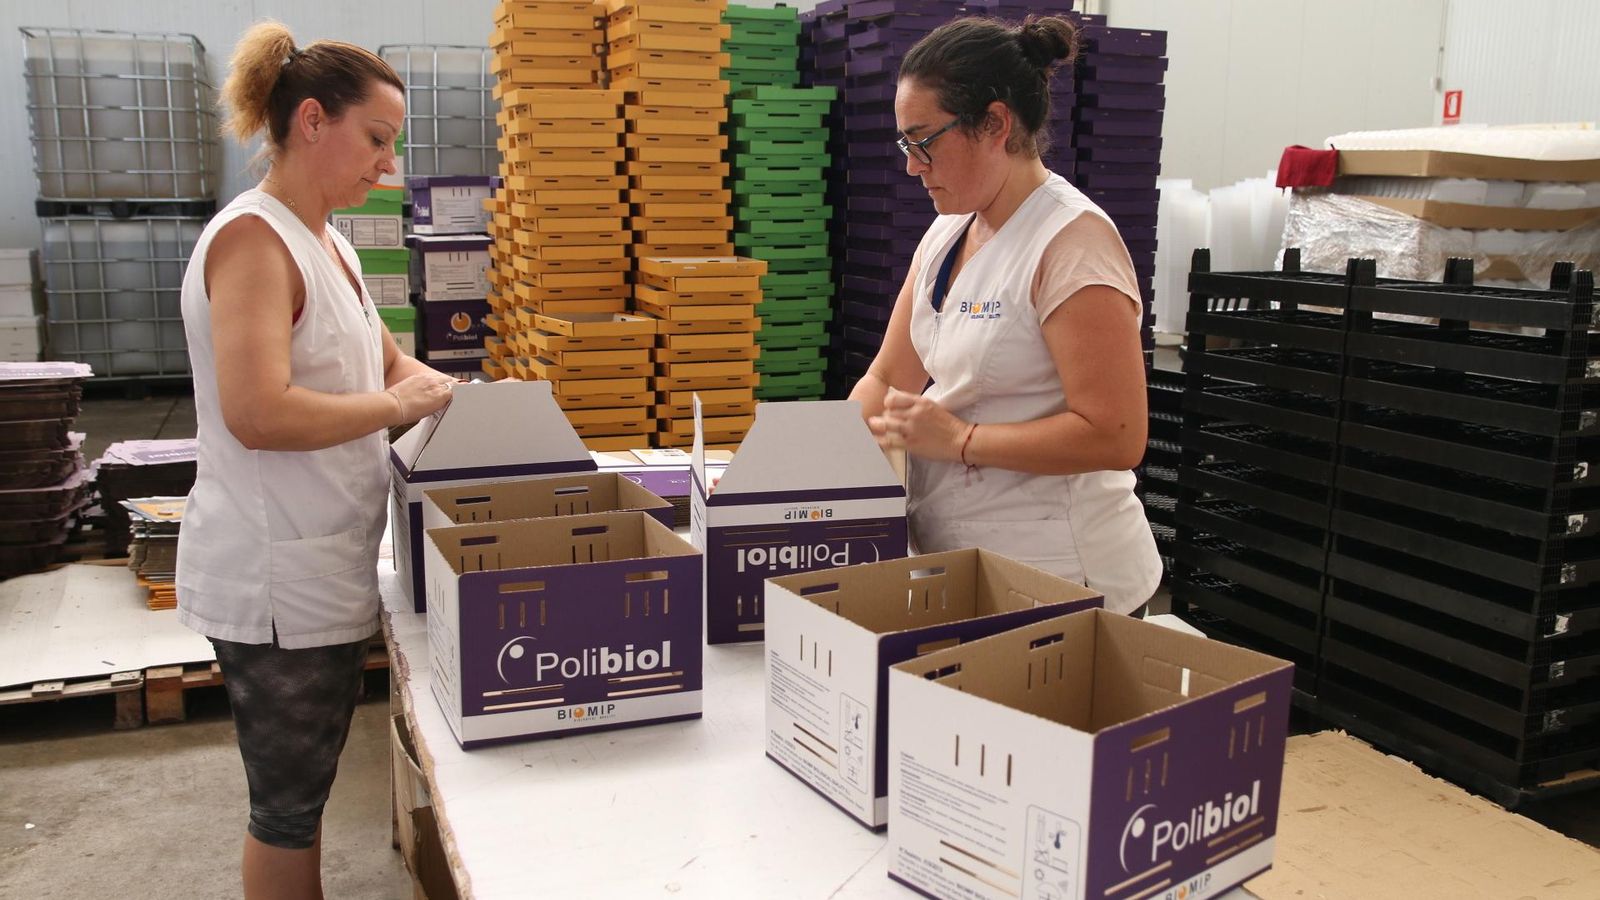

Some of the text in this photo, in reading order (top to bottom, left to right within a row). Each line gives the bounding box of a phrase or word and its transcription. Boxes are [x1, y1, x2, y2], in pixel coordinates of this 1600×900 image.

[960, 301, 1001, 314] BIOMIP
[784, 508, 833, 520] BIOMIP
[737, 542, 849, 573] Polibiol
[536, 640, 671, 682] Polibiol
[557, 703, 616, 720] BIOMIP
[1151, 780, 1260, 862] Polibiol
